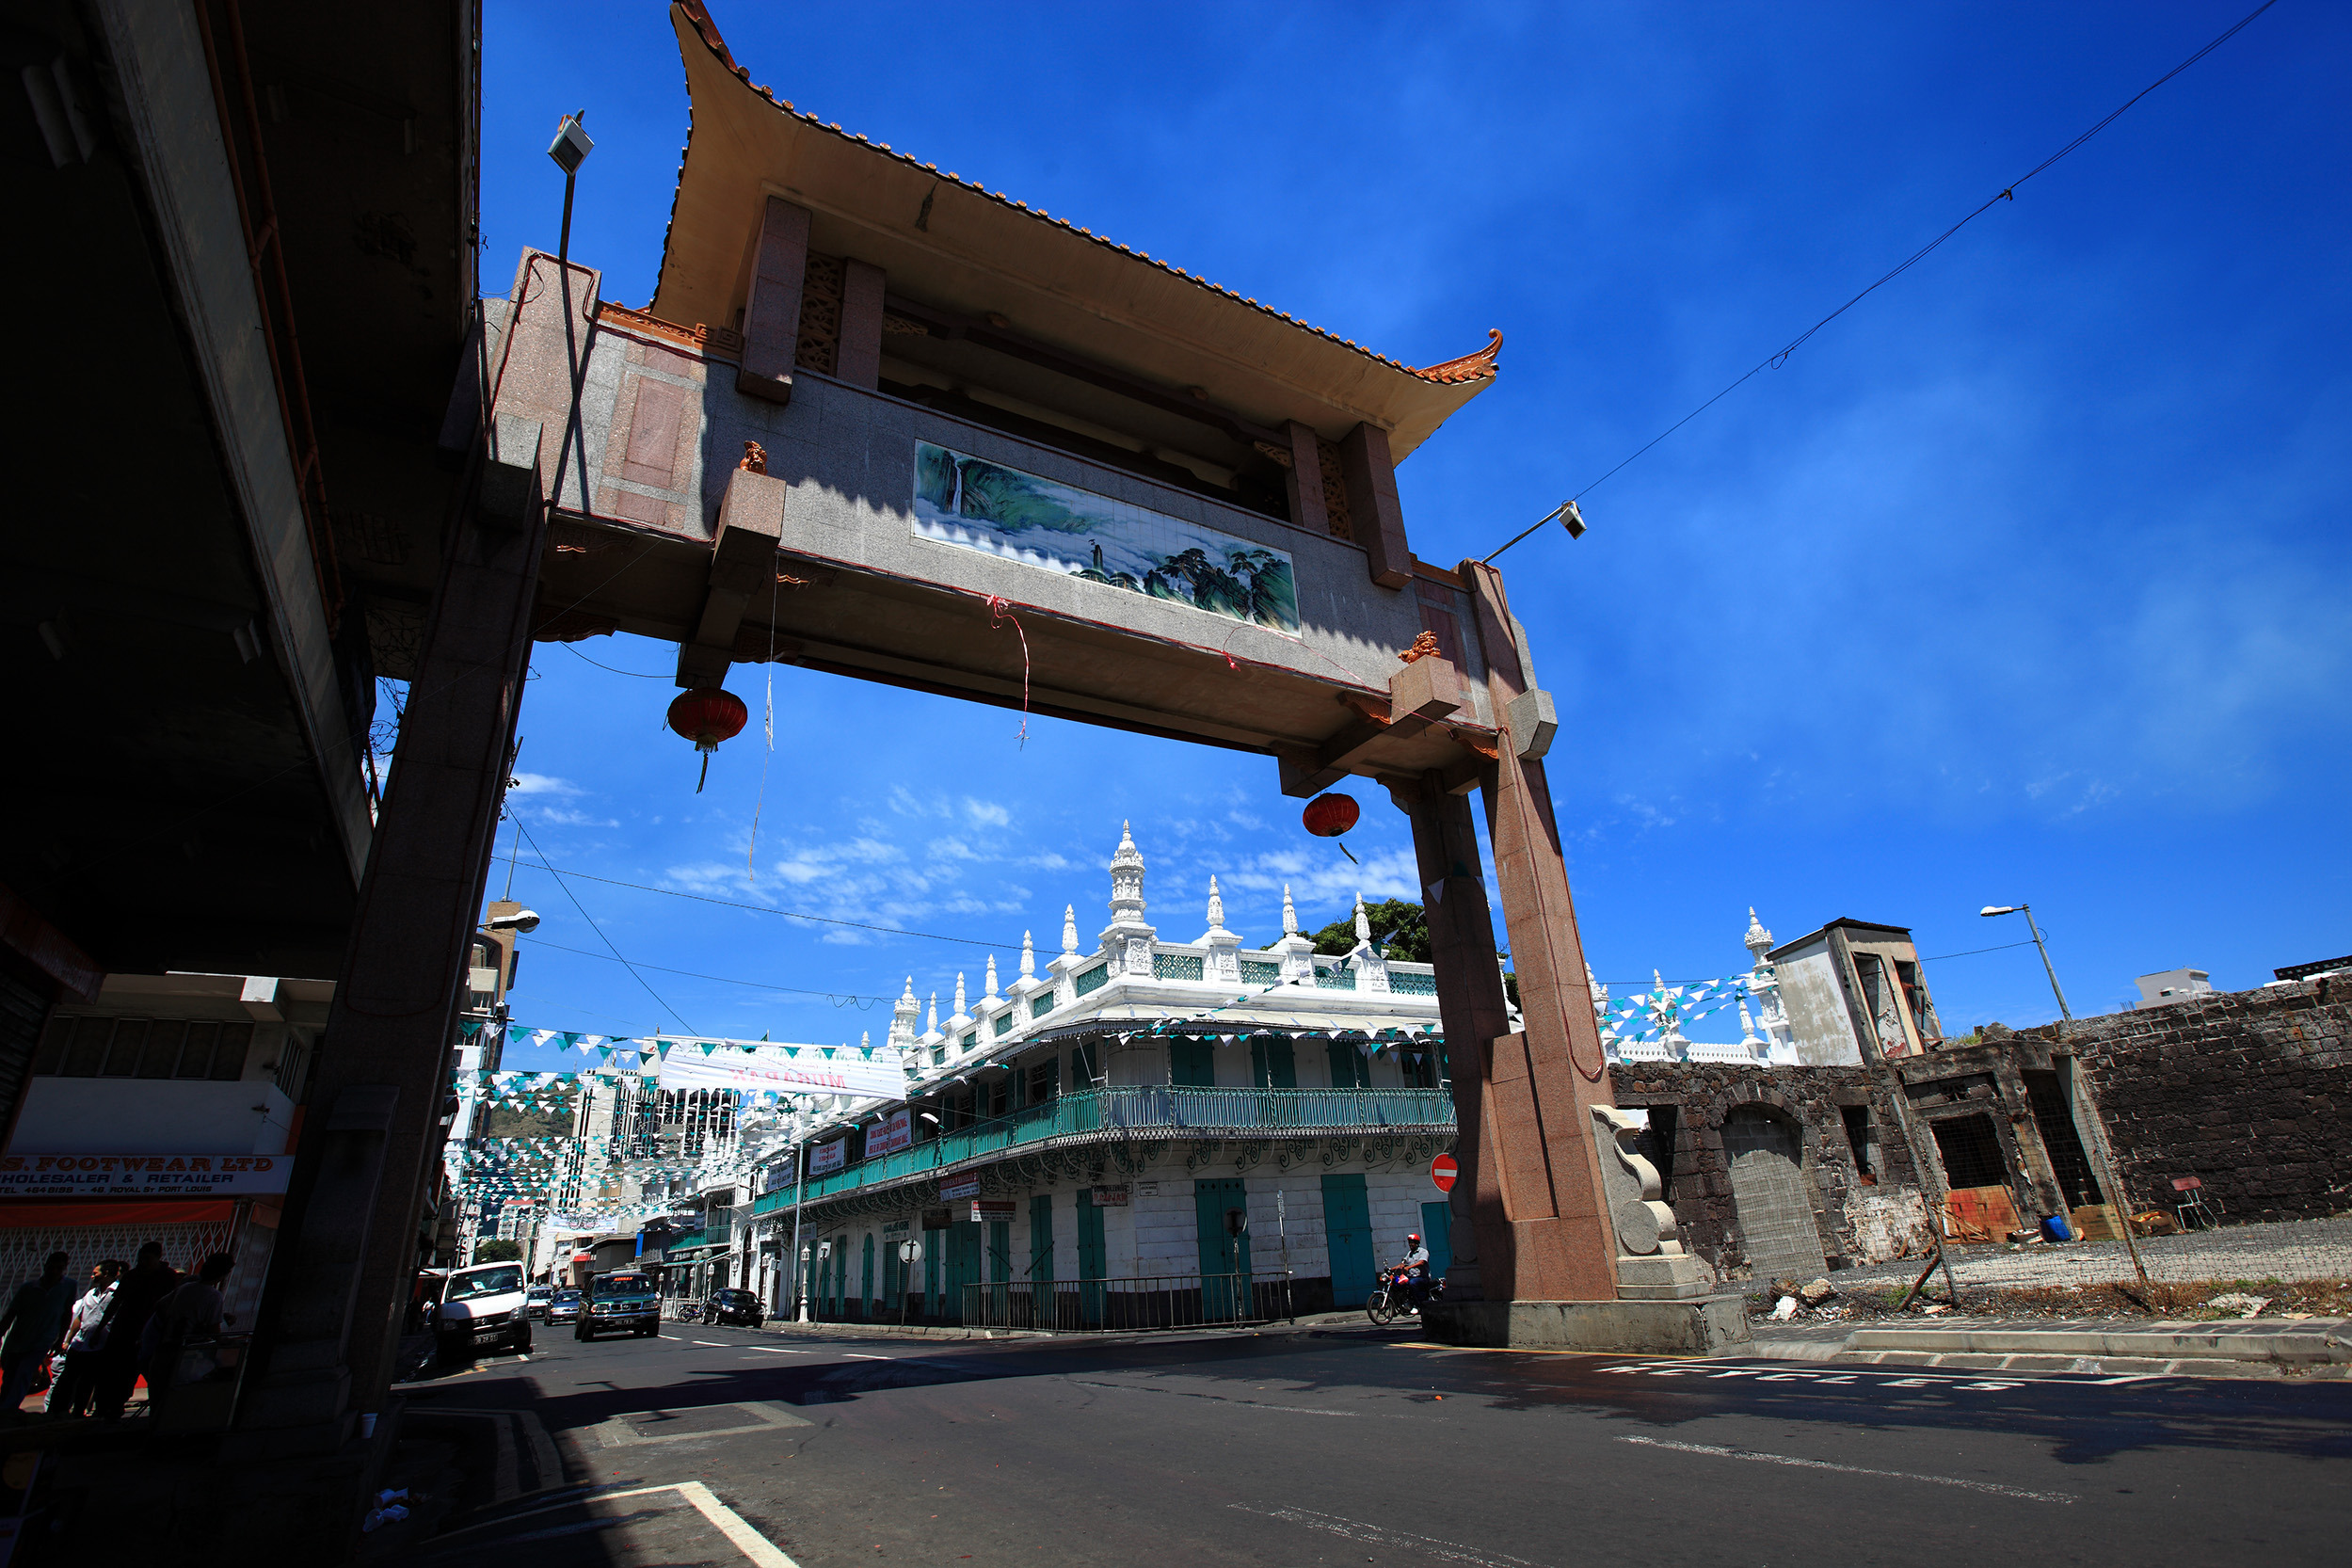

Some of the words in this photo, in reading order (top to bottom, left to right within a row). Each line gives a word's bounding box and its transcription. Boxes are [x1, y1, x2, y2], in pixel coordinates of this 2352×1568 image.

[36, 1157, 212, 1172] FOOTWEAR
[221, 1158, 273, 1172] LTD
[0, 1175, 110, 1184] HOLESALER
[122, 1175, 134, 1183] &
[147, 1174, 234, 1183] RETAILER
[185, 1185, 213, 1193] LOUIS
